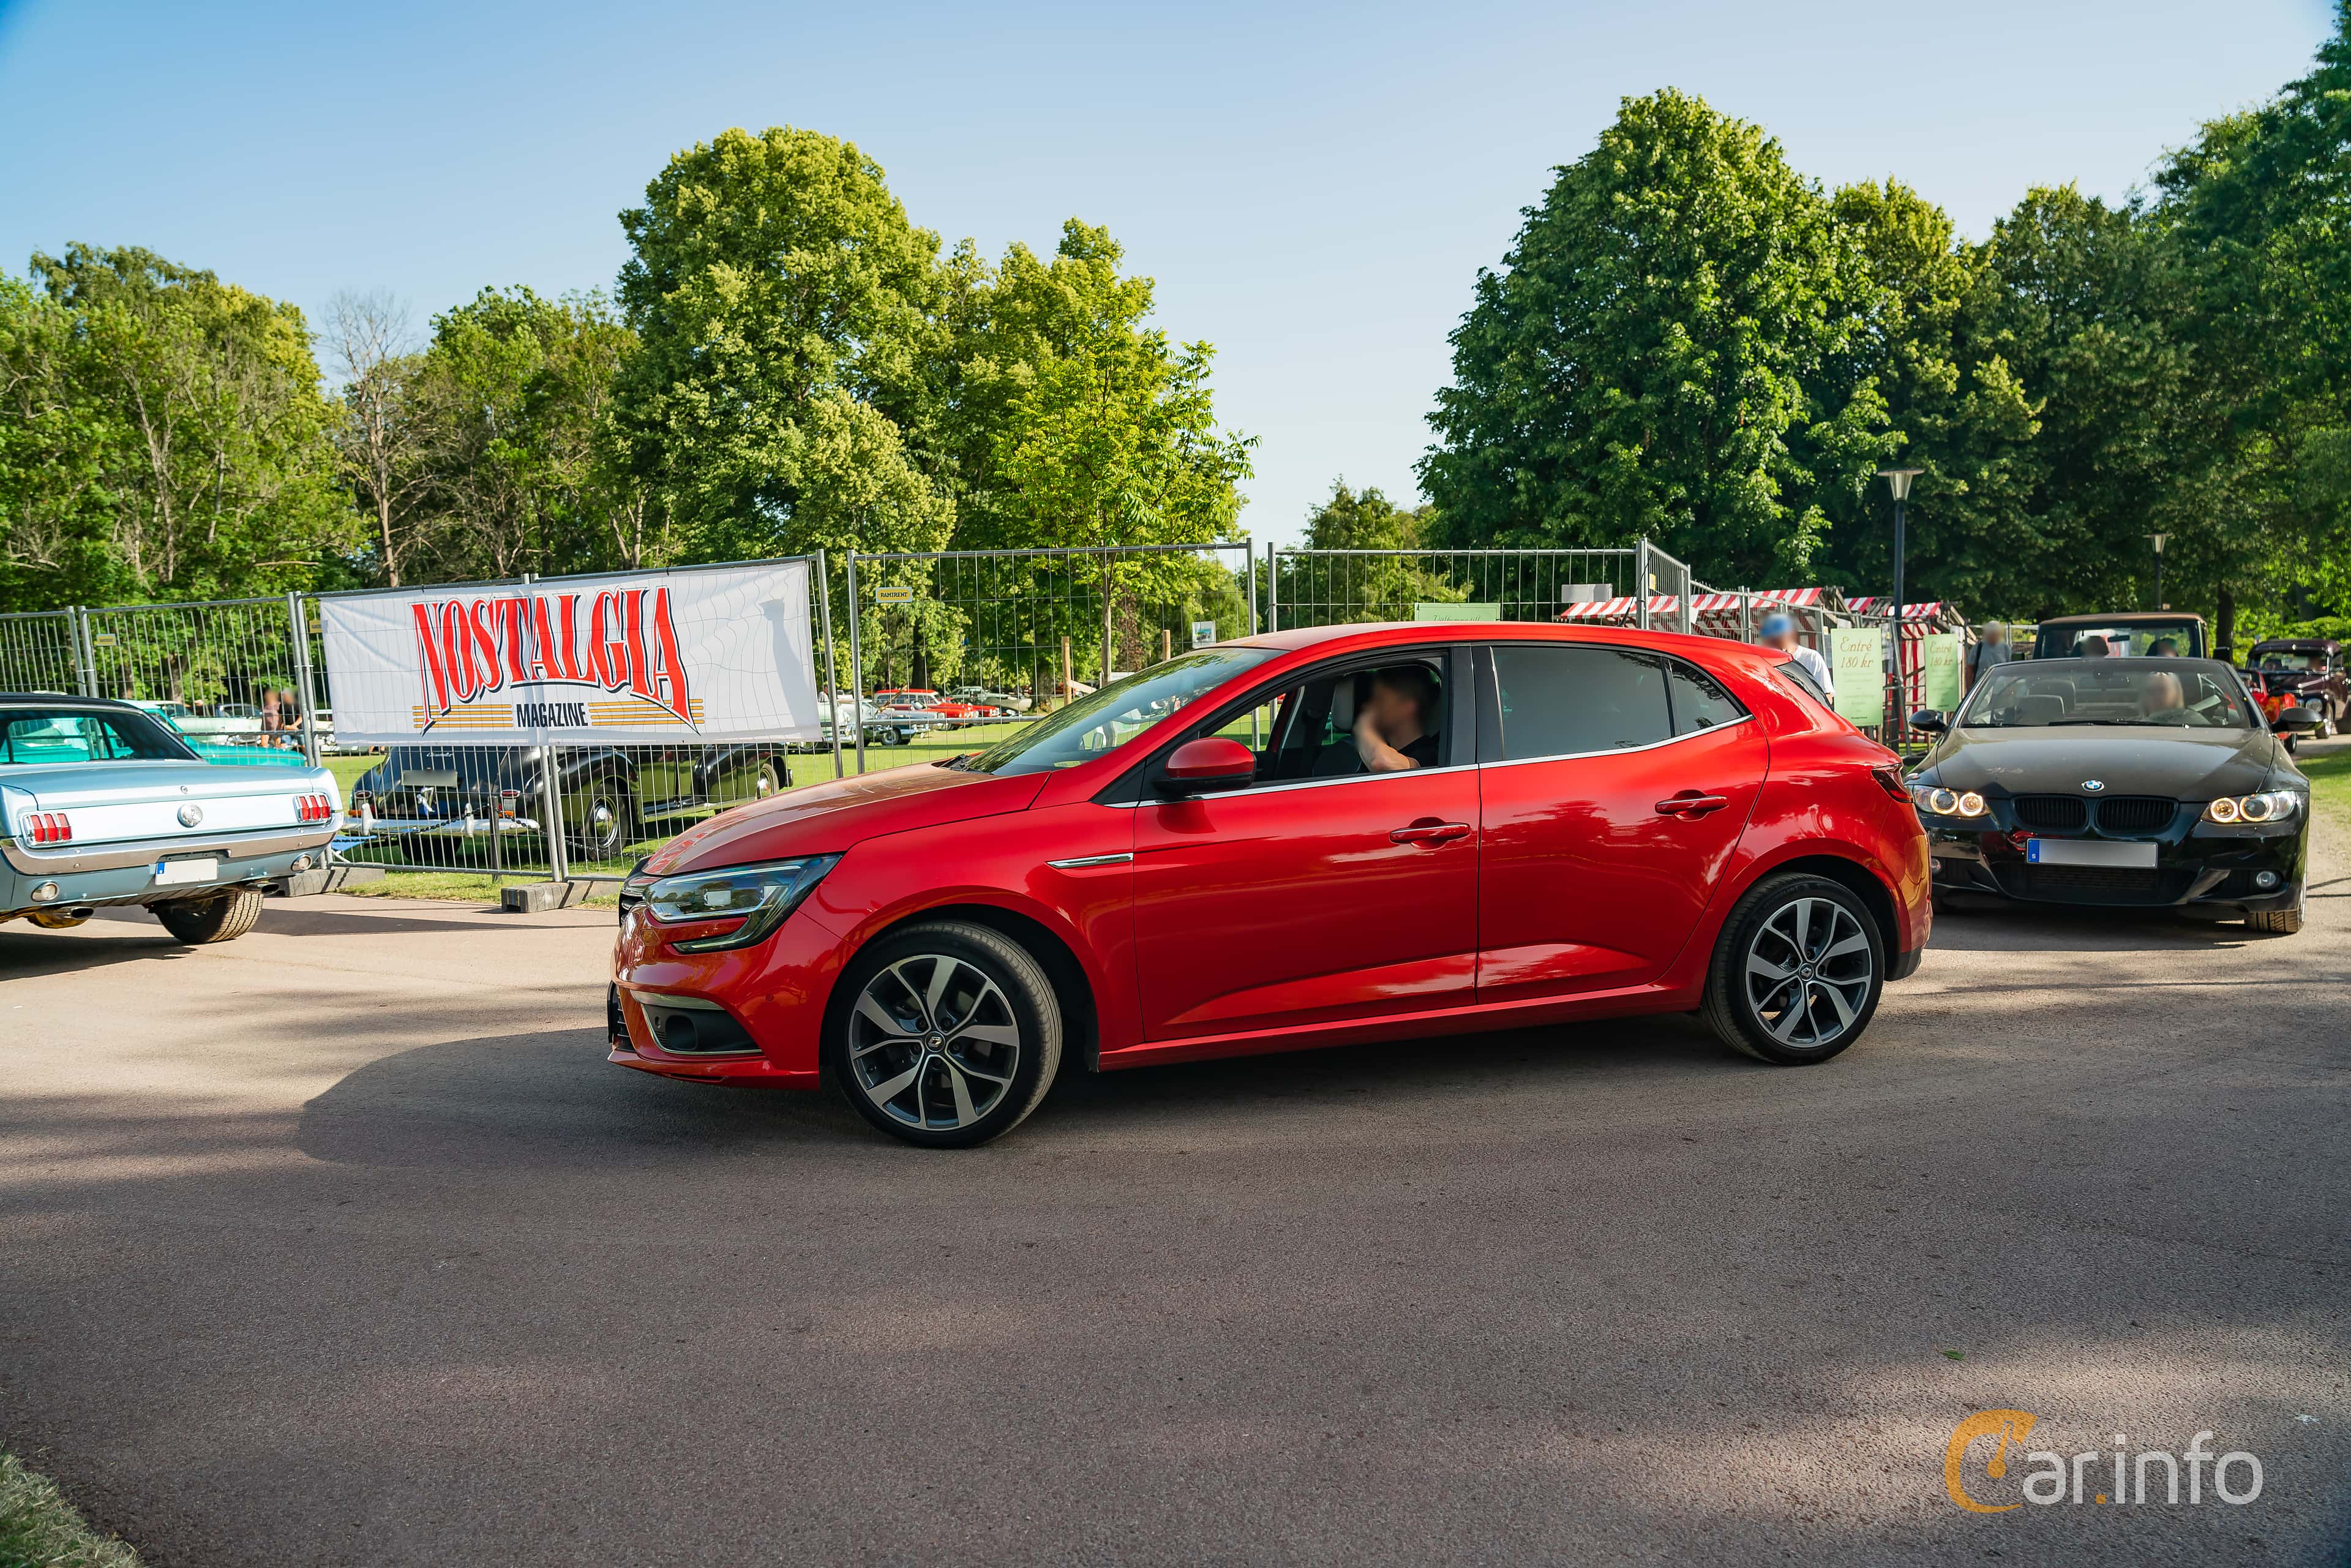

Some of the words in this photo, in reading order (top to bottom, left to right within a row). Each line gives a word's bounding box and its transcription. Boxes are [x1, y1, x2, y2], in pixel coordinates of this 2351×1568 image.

[1840, 636, 1872, 651] Entré
[409, 585, 700, 735] NOSTALGIA
[1841, 656, 1858, 667] 180
[1861, 653, 1873, 667] kr
[516, 703, 588, 727] MAGAZINE
